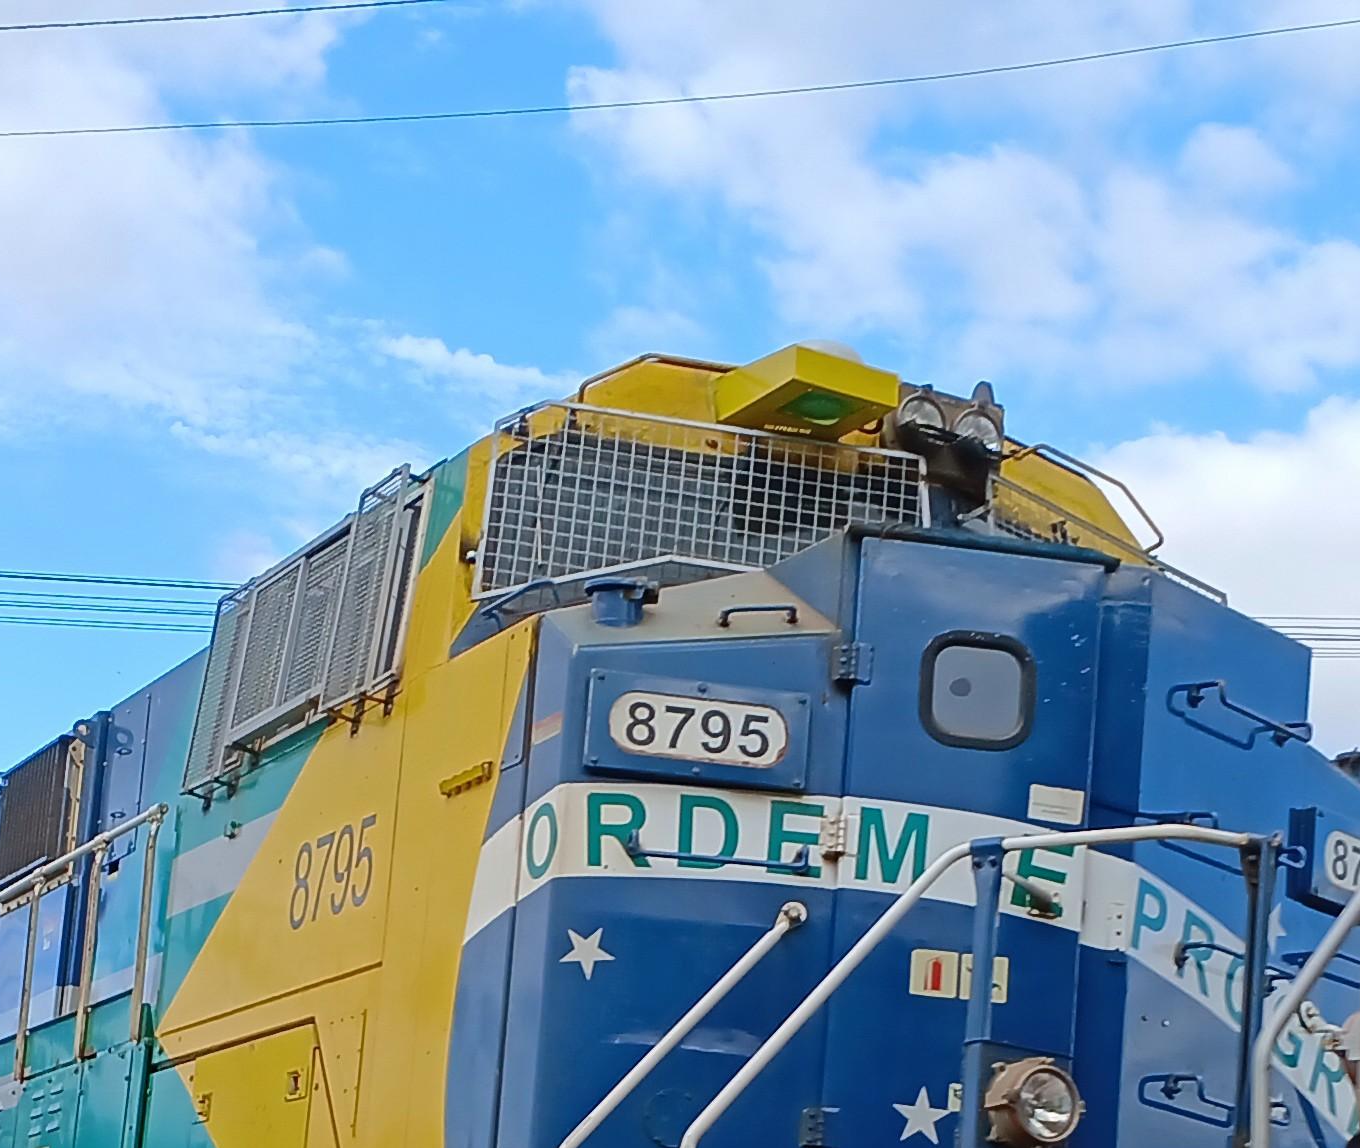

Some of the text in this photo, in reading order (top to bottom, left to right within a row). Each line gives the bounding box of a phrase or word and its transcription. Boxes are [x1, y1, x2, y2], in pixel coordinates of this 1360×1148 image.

[626, 701, 770, 758] 8795
[289, 813, 377, 931] 8795
[526, 792, 929, 886] ORDEM
[1010, 835, 1077, 918] E
